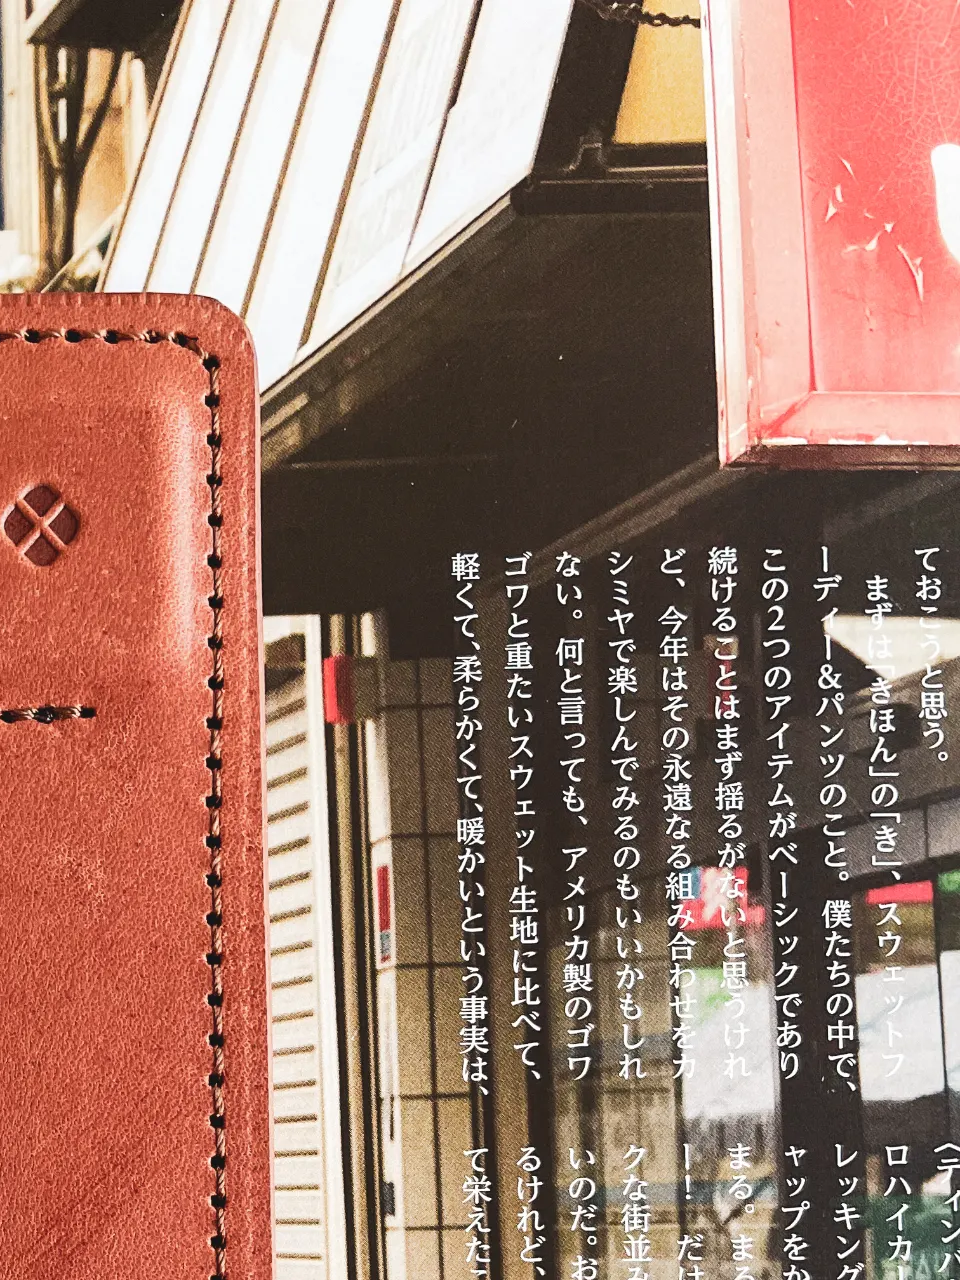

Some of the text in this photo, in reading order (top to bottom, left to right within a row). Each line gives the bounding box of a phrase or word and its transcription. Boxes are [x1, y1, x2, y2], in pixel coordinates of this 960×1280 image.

[607, 551, 646, 1079] シミヤで楽しんでみるのもいいかもしれ
[915, 547, 949, 761] ておこうと思う。
